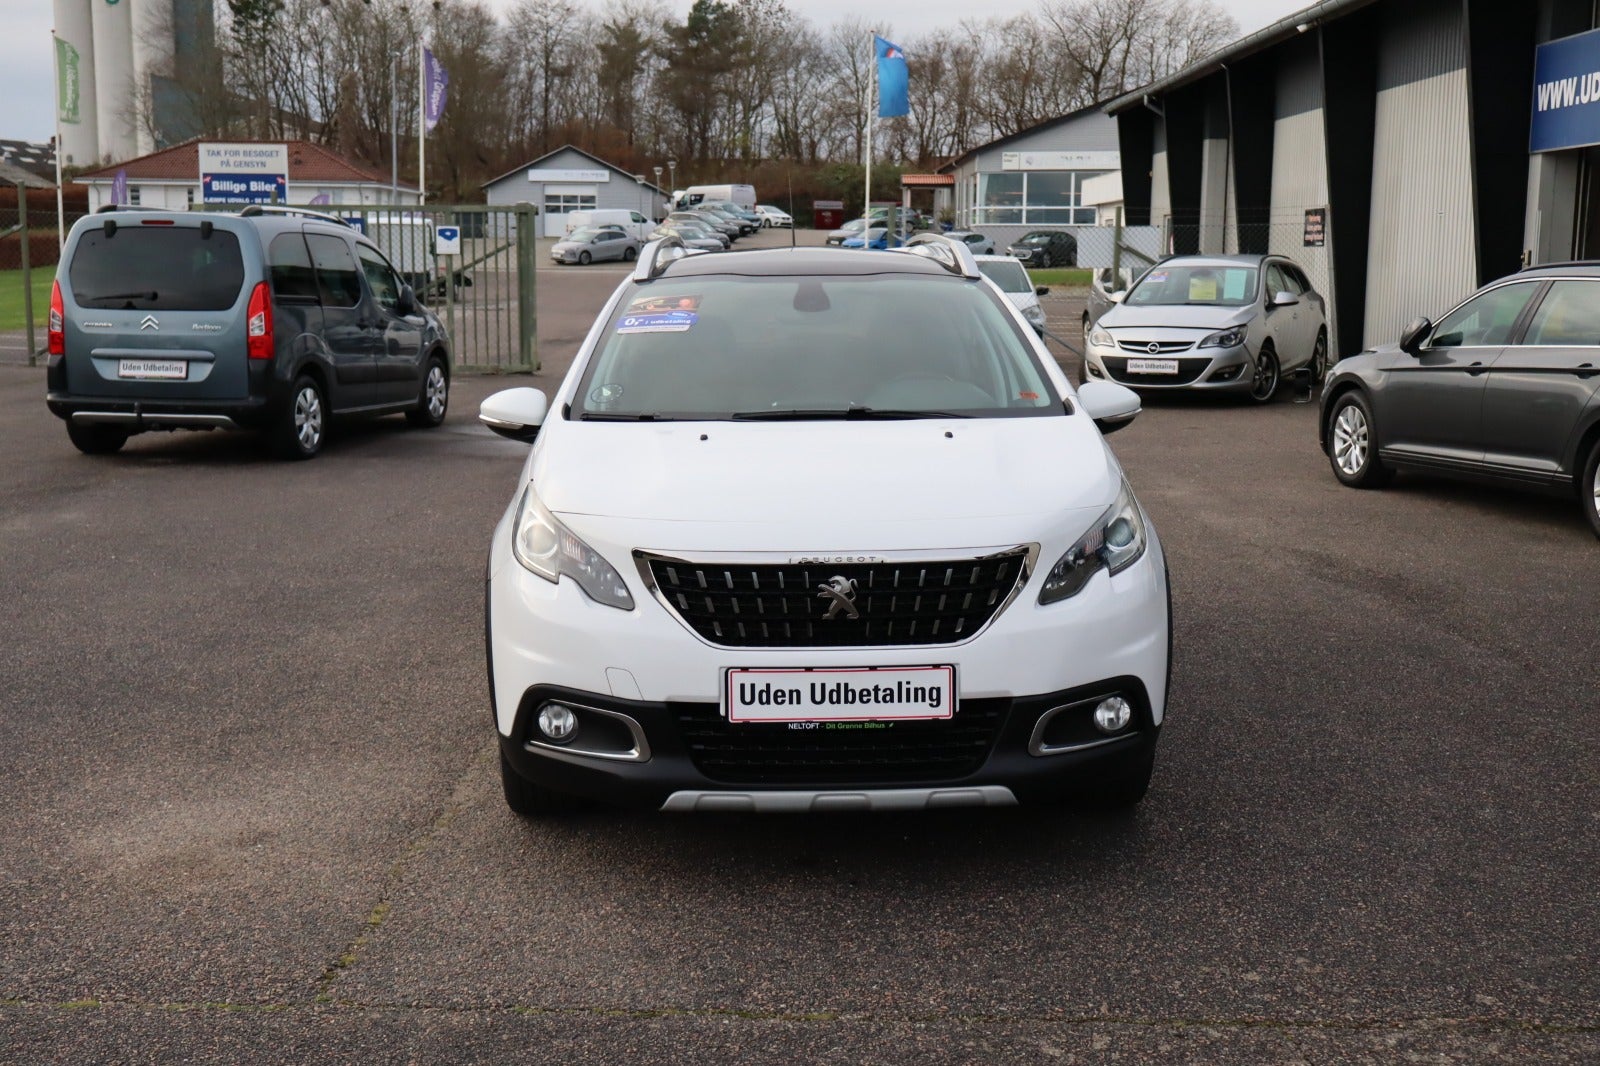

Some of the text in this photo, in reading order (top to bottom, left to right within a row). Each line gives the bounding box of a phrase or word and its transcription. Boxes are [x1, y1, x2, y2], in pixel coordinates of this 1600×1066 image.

[220, 159, 231, 168] PÅ
[211, 180, 277, 193] Billige Biler
[122, 363, 184, 374] Uden Udbetaling
[739, 681, 942, 709] Uden Udbetaling
[788, 722, 820, 730] NELTOFT
